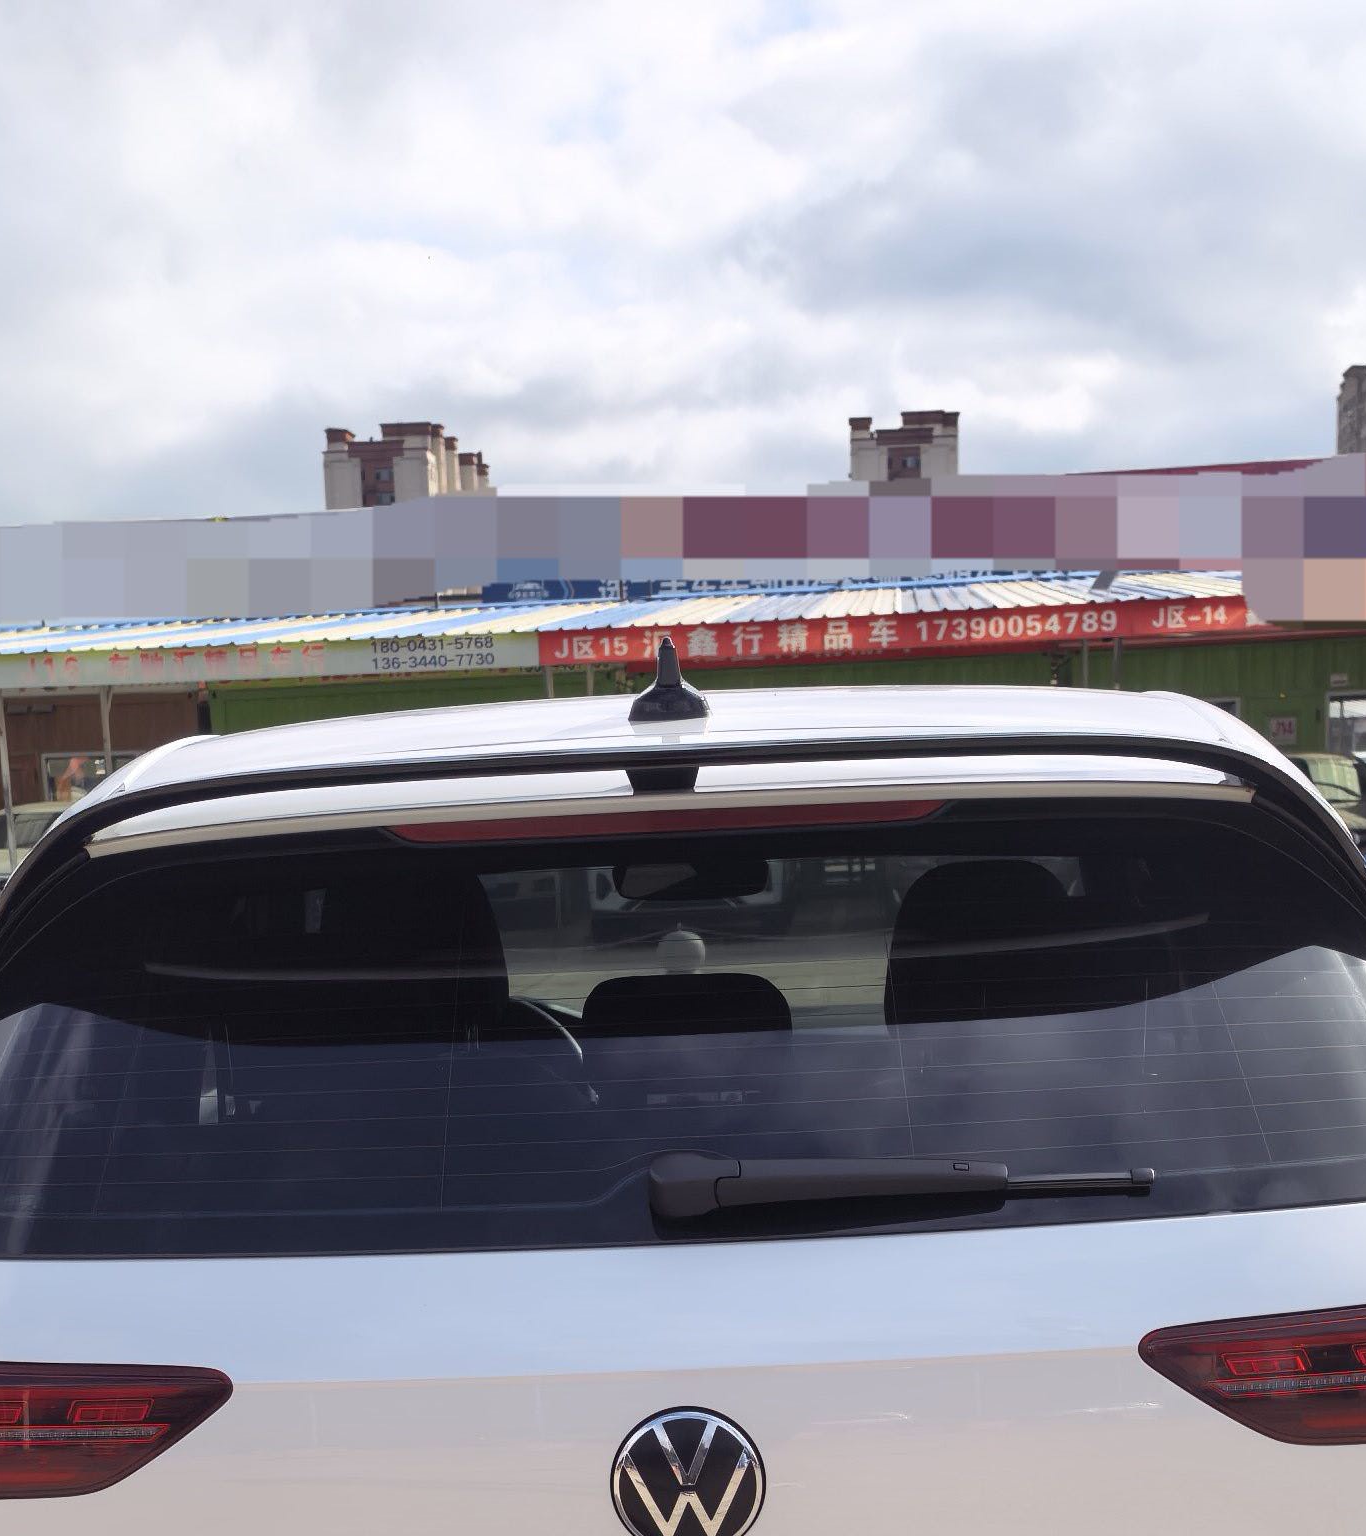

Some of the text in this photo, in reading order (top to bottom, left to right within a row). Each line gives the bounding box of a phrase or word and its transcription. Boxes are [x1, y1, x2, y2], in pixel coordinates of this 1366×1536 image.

[917, 610, 1117, 641] 17390054789
[1152, 604, 1228, 629] J区-14
[371, 635, 494, 653] 180-0431-5768
[554, 636, 628, 659] J区15
[373, 653, 495, 669] 136-3440-7730
